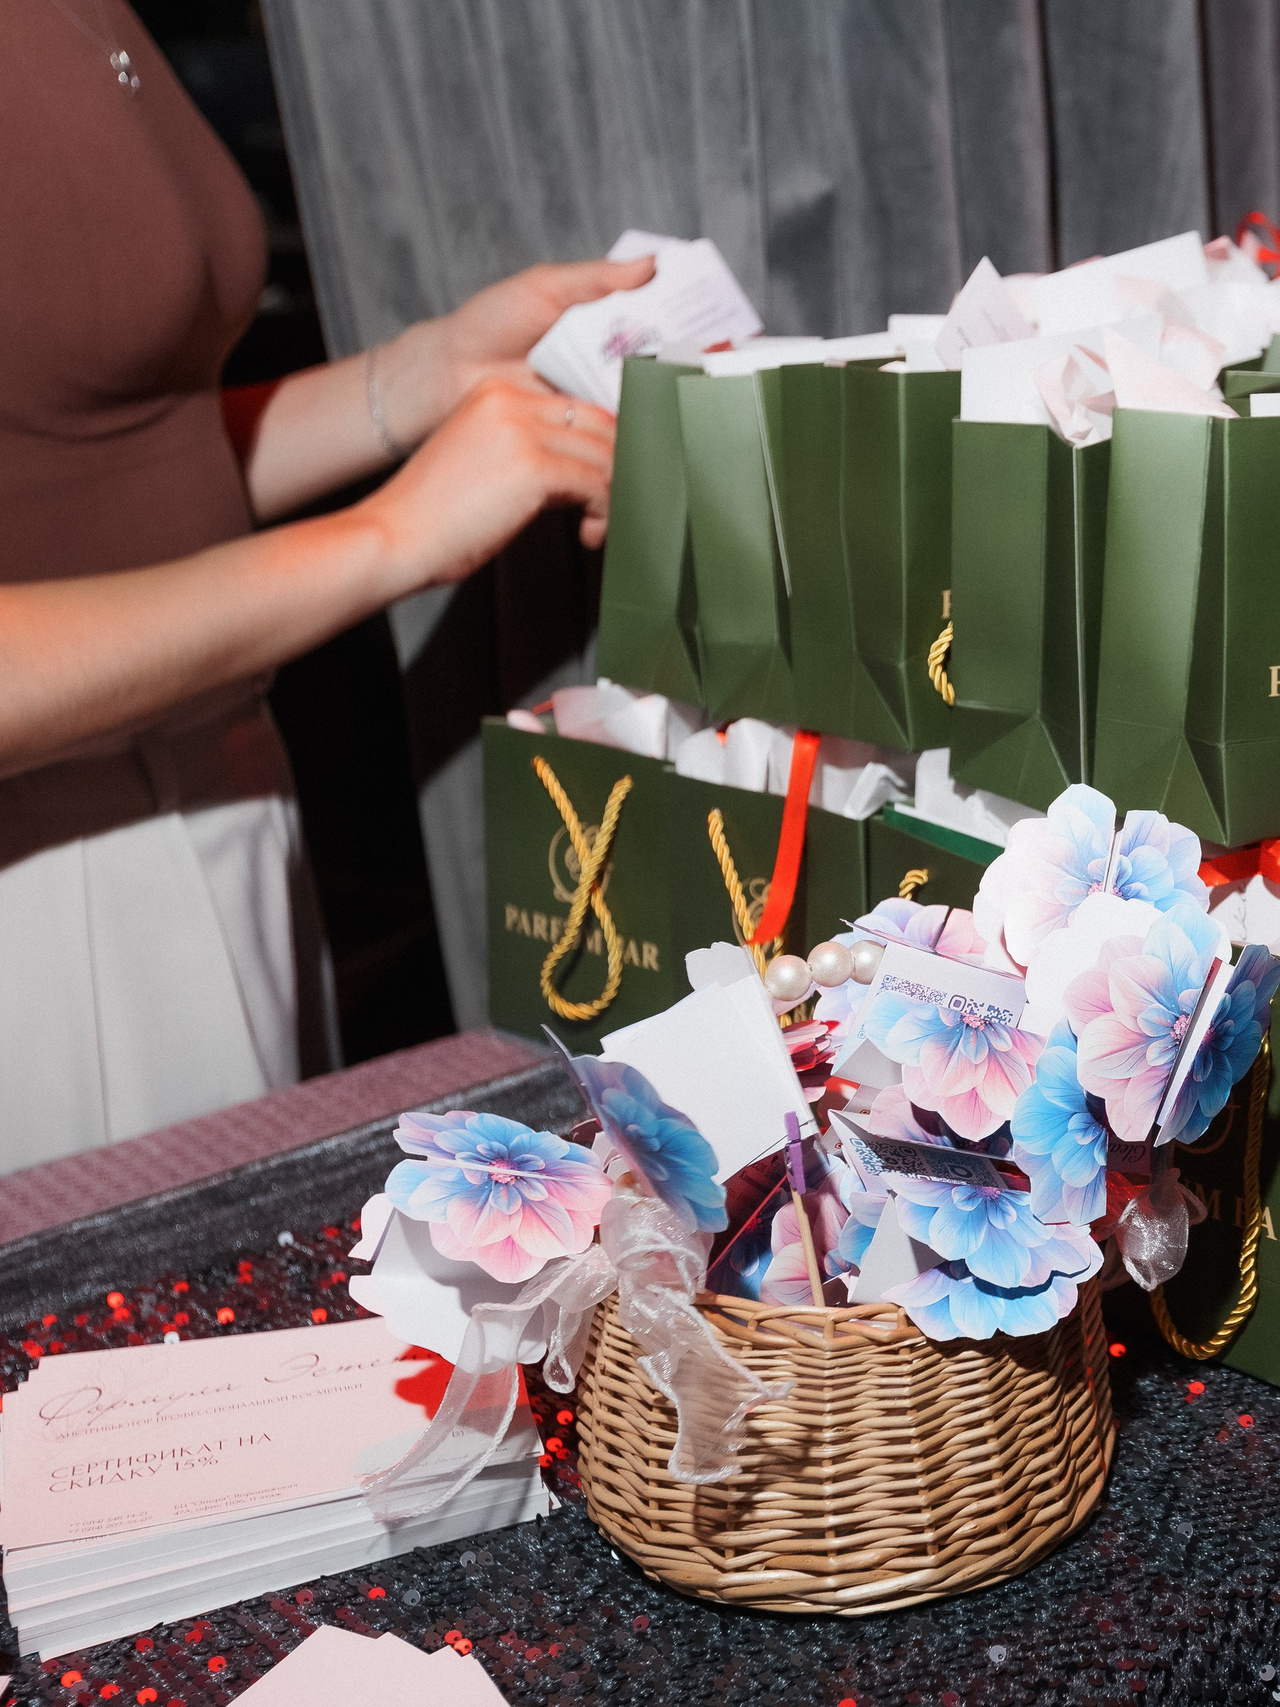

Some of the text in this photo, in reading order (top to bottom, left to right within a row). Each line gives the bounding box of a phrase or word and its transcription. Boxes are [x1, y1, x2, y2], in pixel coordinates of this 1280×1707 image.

[618, 933, 661, 973] AR
[1108, 1142, 1146, 1164] Clea
[49, 1454, 220, 1493] СКИДКУ 15%
[51, 1432, 273, 1480] СЕРТИФИКАТ НА
